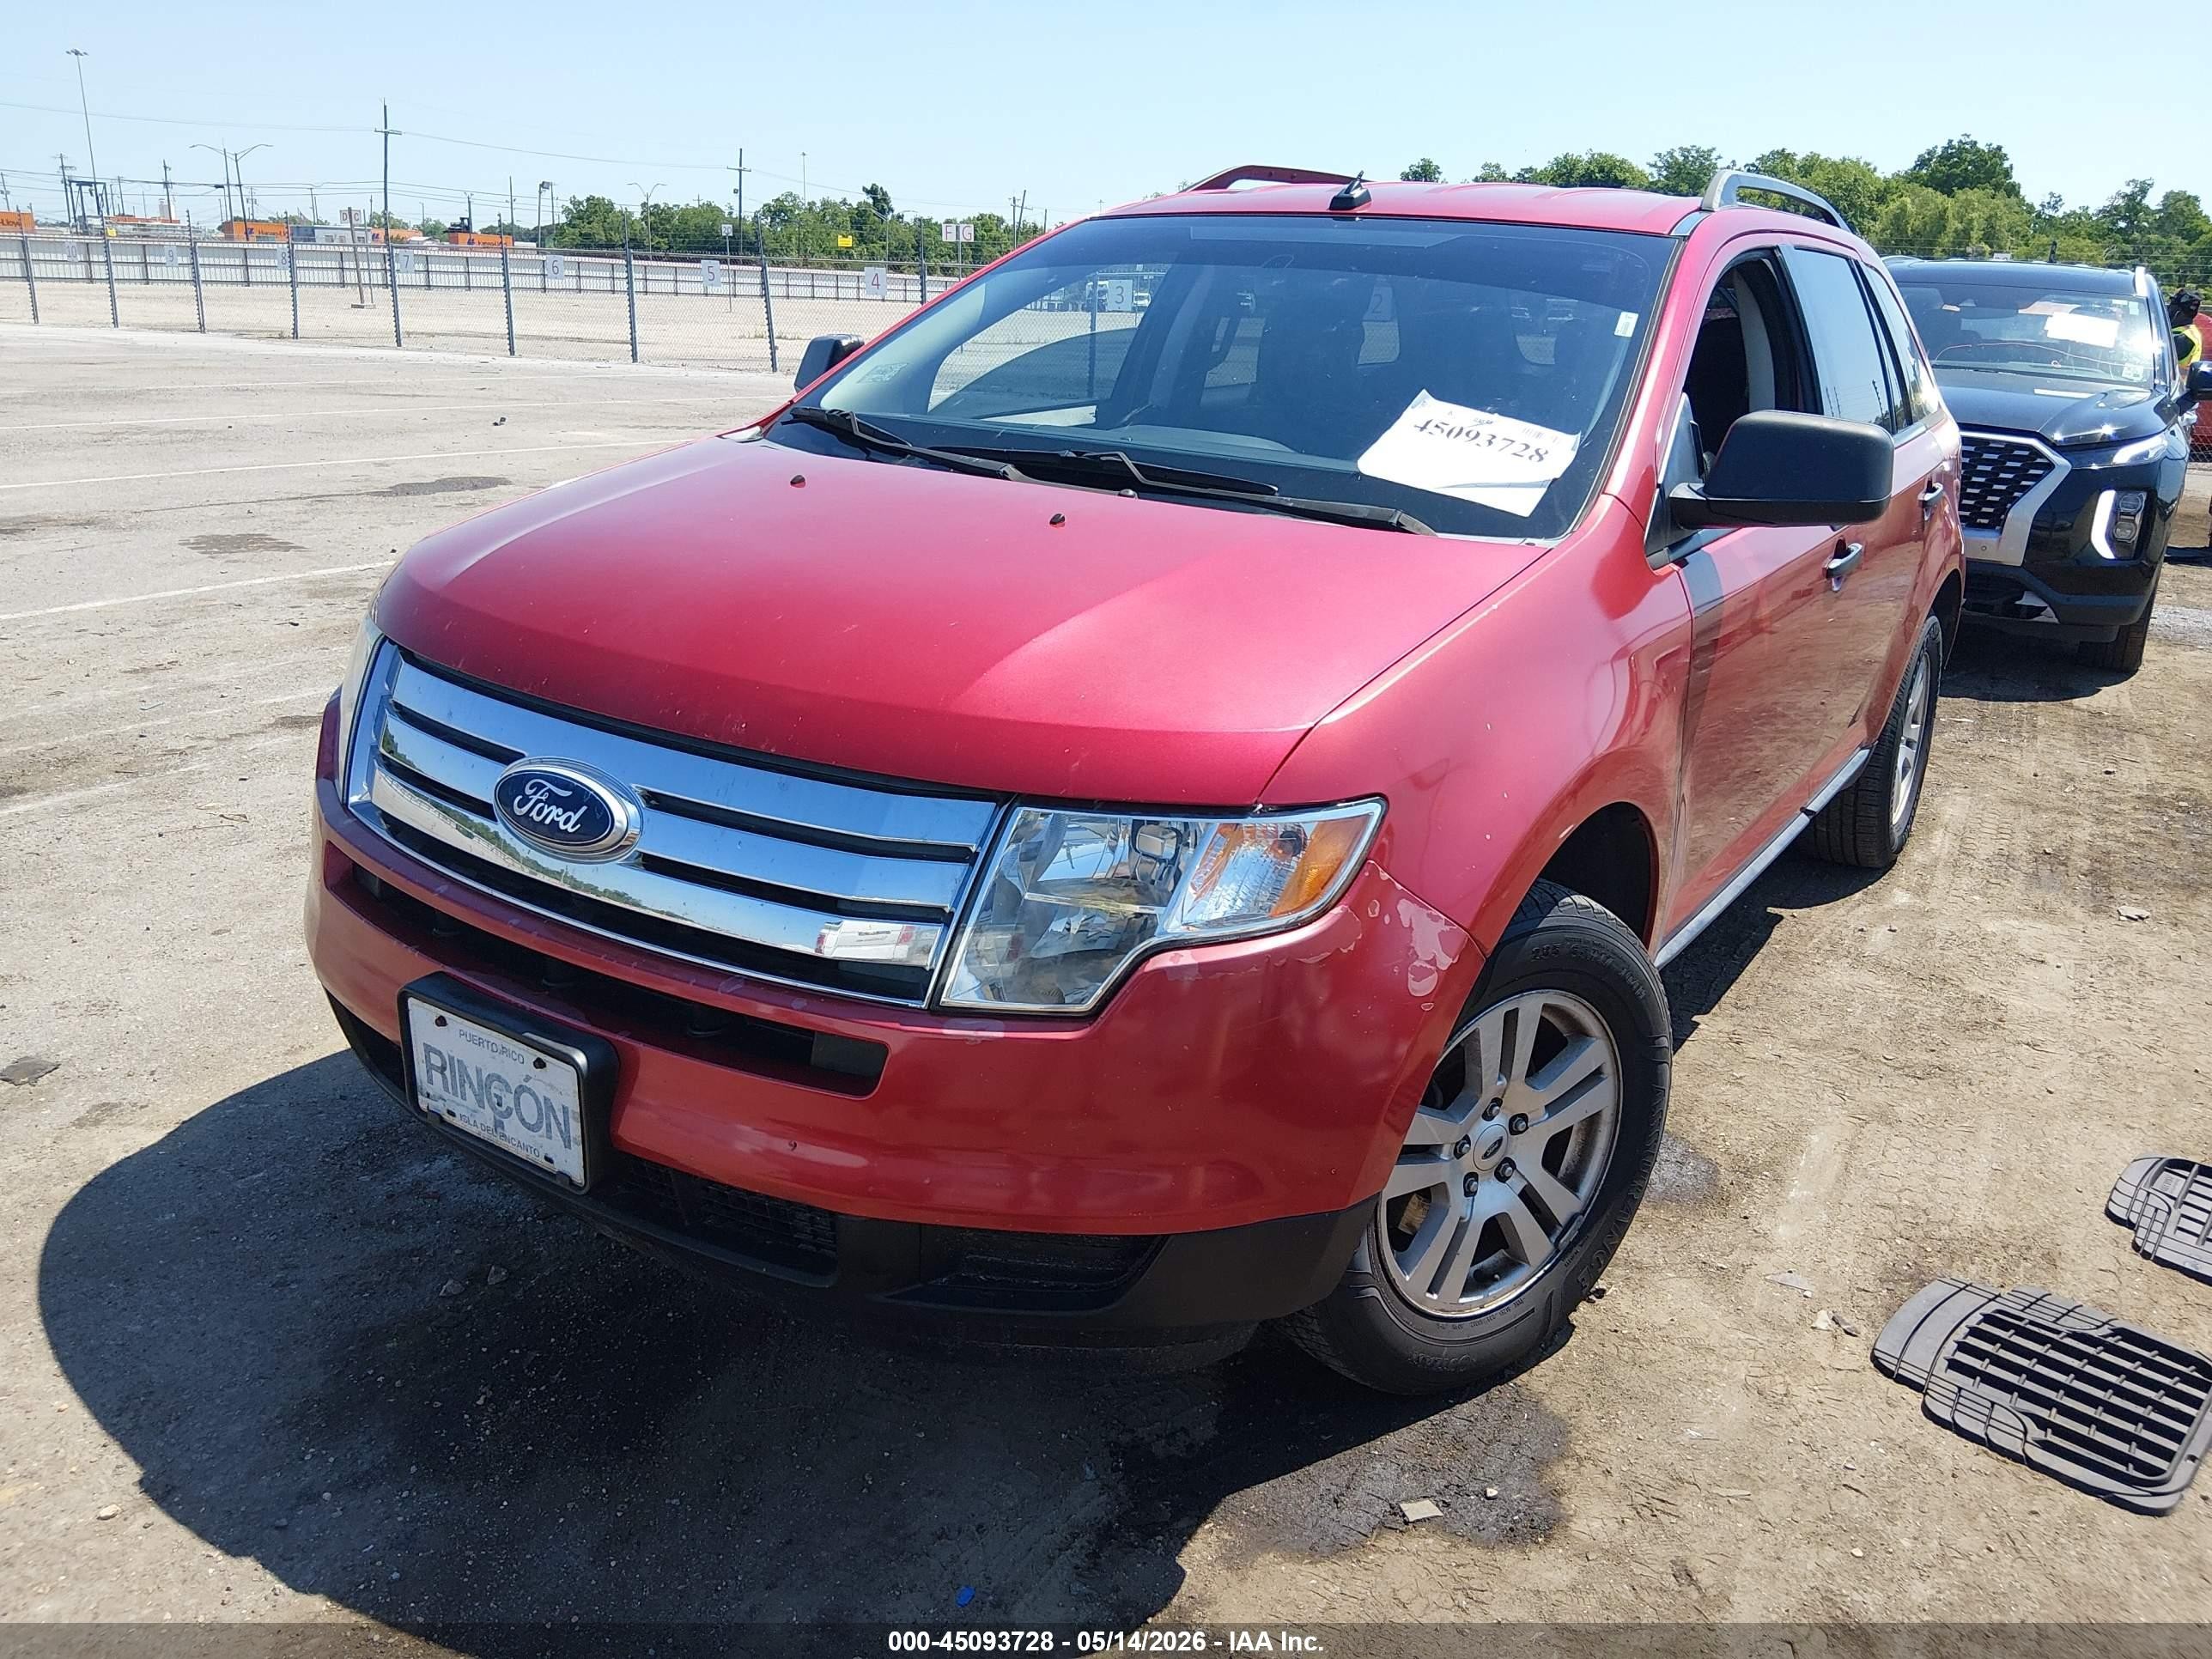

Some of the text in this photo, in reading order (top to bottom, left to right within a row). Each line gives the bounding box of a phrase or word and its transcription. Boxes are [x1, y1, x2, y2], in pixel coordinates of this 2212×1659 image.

[342, 212, 349, 222] D
[353, 211, 360, 222] C
[722, 226, 732, 234] 20
[945, 225, 952, 241] F
[962, 225, 972, 241] G
[68, 245, 78, 258] 10
[167, 249, 174, 263] 9
[281, 252, 287, 265] 8
[402, 254, 410, 269] 7
[551, 259, 560, 275] 6
[707, 265, 715, 282] 5
[871, 272, 881, 290] 4
[1114, 285, 1125, 305] 3
[1371, 294, 1382, 314] 2
[1413, 418, 1549, 463] 45093728
[513, 778, 588, 833] Ford
[459, 1029, 525, 1065] PUERTO RICO
[422, 1042, 573, 1151] RINCÓN
[459, 1113, 540, 1158] ISLA DEL ENCANTO
